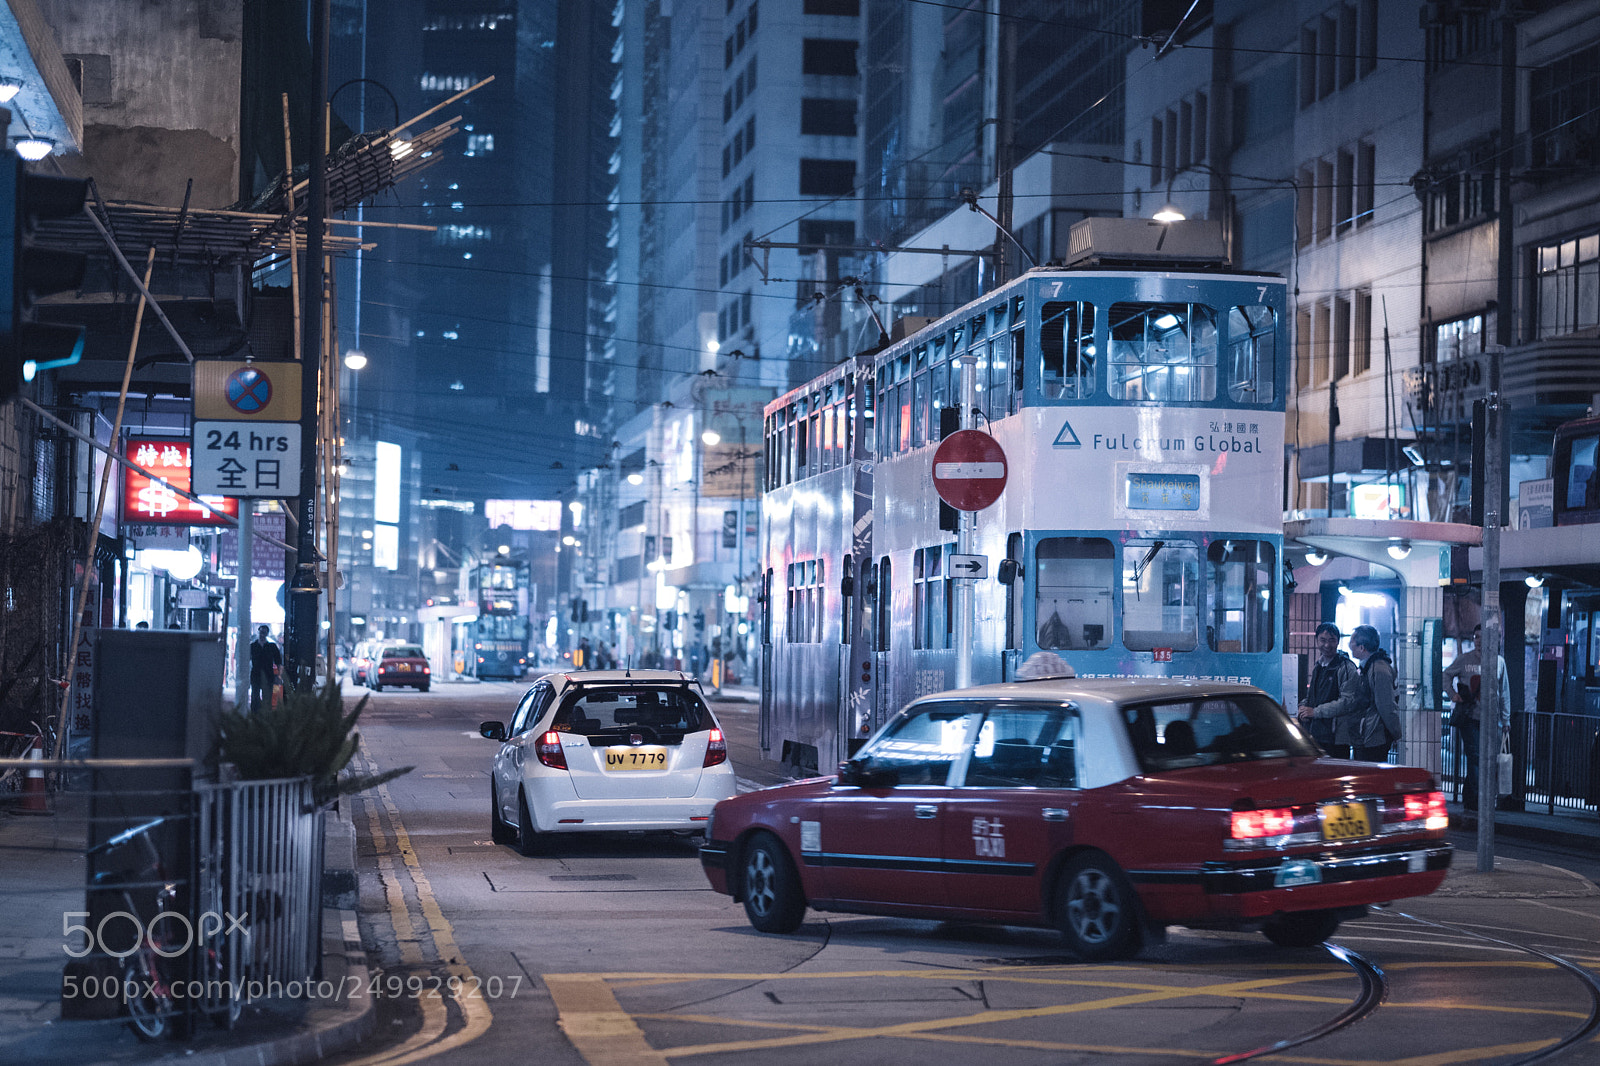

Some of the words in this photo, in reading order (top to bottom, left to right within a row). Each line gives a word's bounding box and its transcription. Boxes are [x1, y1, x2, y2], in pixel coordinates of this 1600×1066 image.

[1051, 281, 1063, 298] 7
[1256, 286, 1267, 302] 7
[1209, 422, 1259, 434] 弘捷國際
[207, 430, 241, 450] 24
[250, 431, 288, 452] hrs
[1093, 433, 1185, 451] Fulcrum
[1194, 435, 1262, 453] Global
[217, 457, 280, 490] 全日
[607, 754, 624, 765] UV
[630, 753, 665, 764] 7779
[972, 816, 1005, 836] 的士
[972, 836, 1005, 857] TAXI
